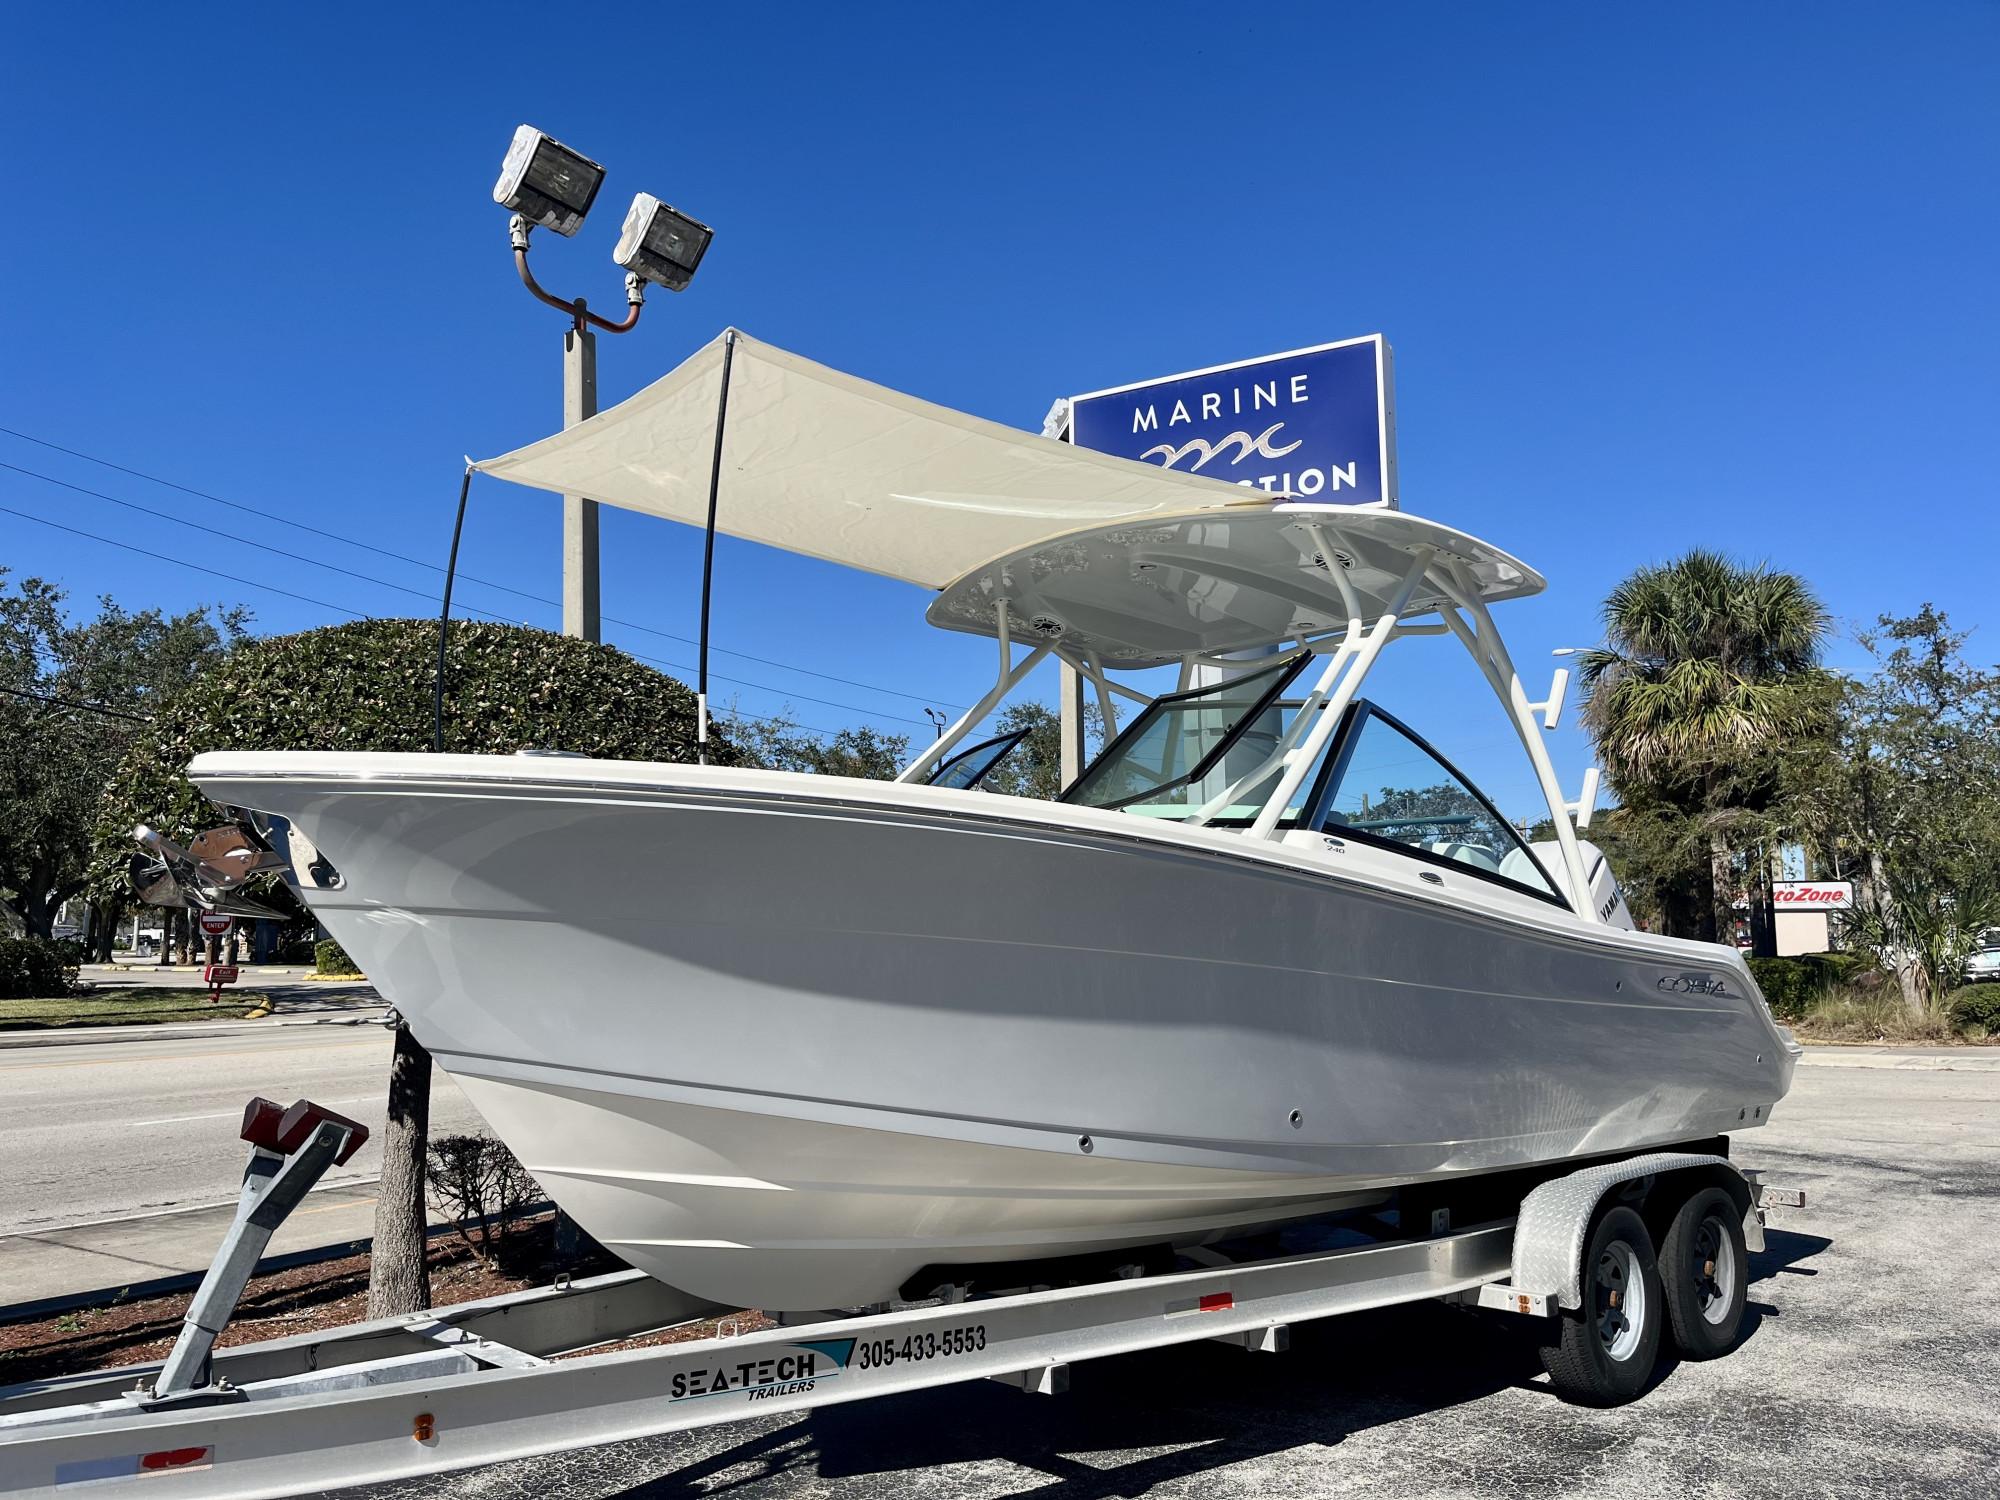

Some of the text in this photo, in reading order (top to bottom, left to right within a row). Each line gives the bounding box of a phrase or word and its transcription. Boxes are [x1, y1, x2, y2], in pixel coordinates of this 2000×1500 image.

[1132, 374, 1309, 434] MARINE
[1237, 461, 1356, 498] TION
[1773, 888, 1844, 902] toZone
[859, 1324, 987, 1370] 305-433-5553
[671, 1353, 815, 1398] SEA-TECH
[747, 1379, 816, 1401] TRAILERS
